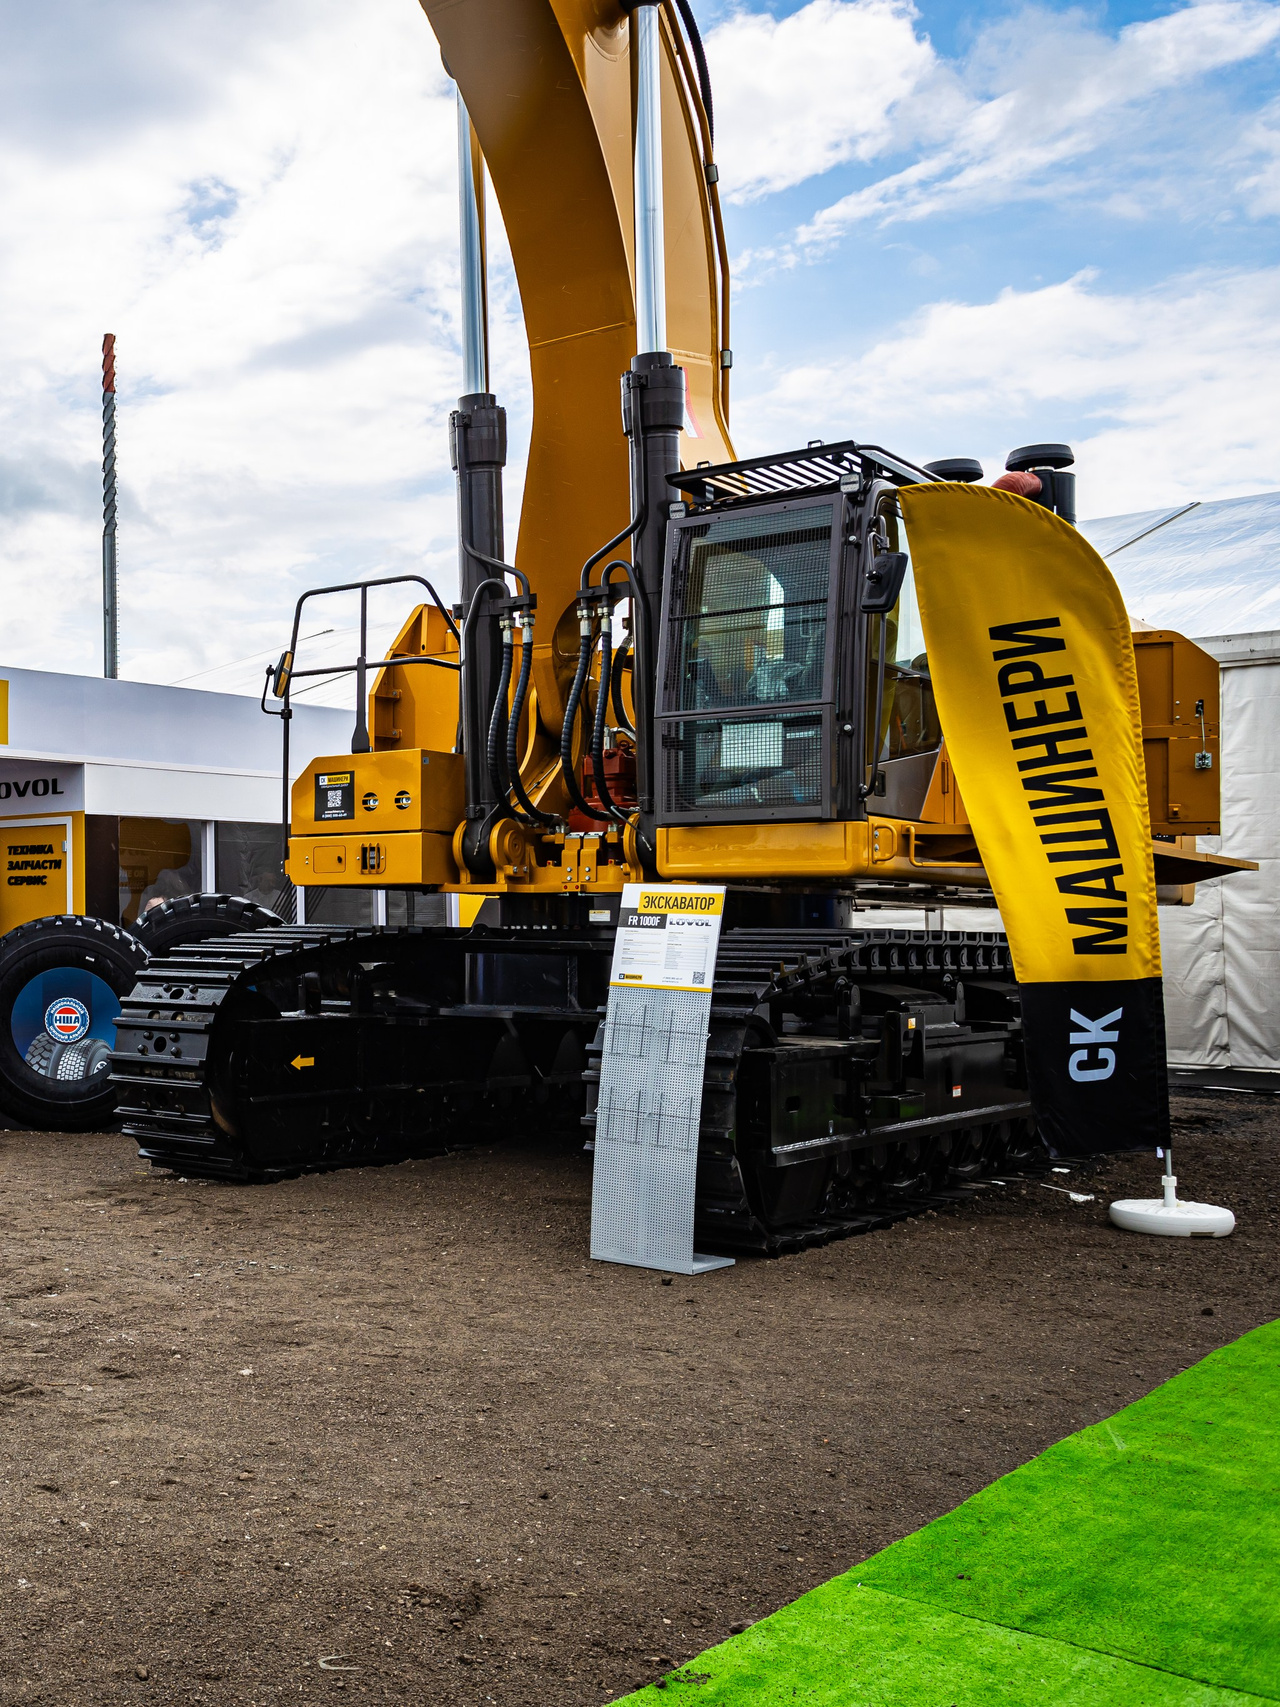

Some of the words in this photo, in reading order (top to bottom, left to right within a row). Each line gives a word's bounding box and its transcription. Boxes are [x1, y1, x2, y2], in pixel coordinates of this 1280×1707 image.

[988, 617, 1128, 955] МАШИНЕРИ
[6, 843, 55, 856] ТЕХНИКА
[6, 858, 63, 871] ЗАПЧАСТИ
[6, 874, 48, 887] СЕРВИС
[642, 895, 715, 911] ЭКСКАВАТОР
[627, 915, 639, 926] FR
[639, 916, 661, 927] 1000F
[669, 917, 712, 927] LOVOL
[54, 1015, 80, 1025] НША
[1068, 1006, 1123, 1083] СК
